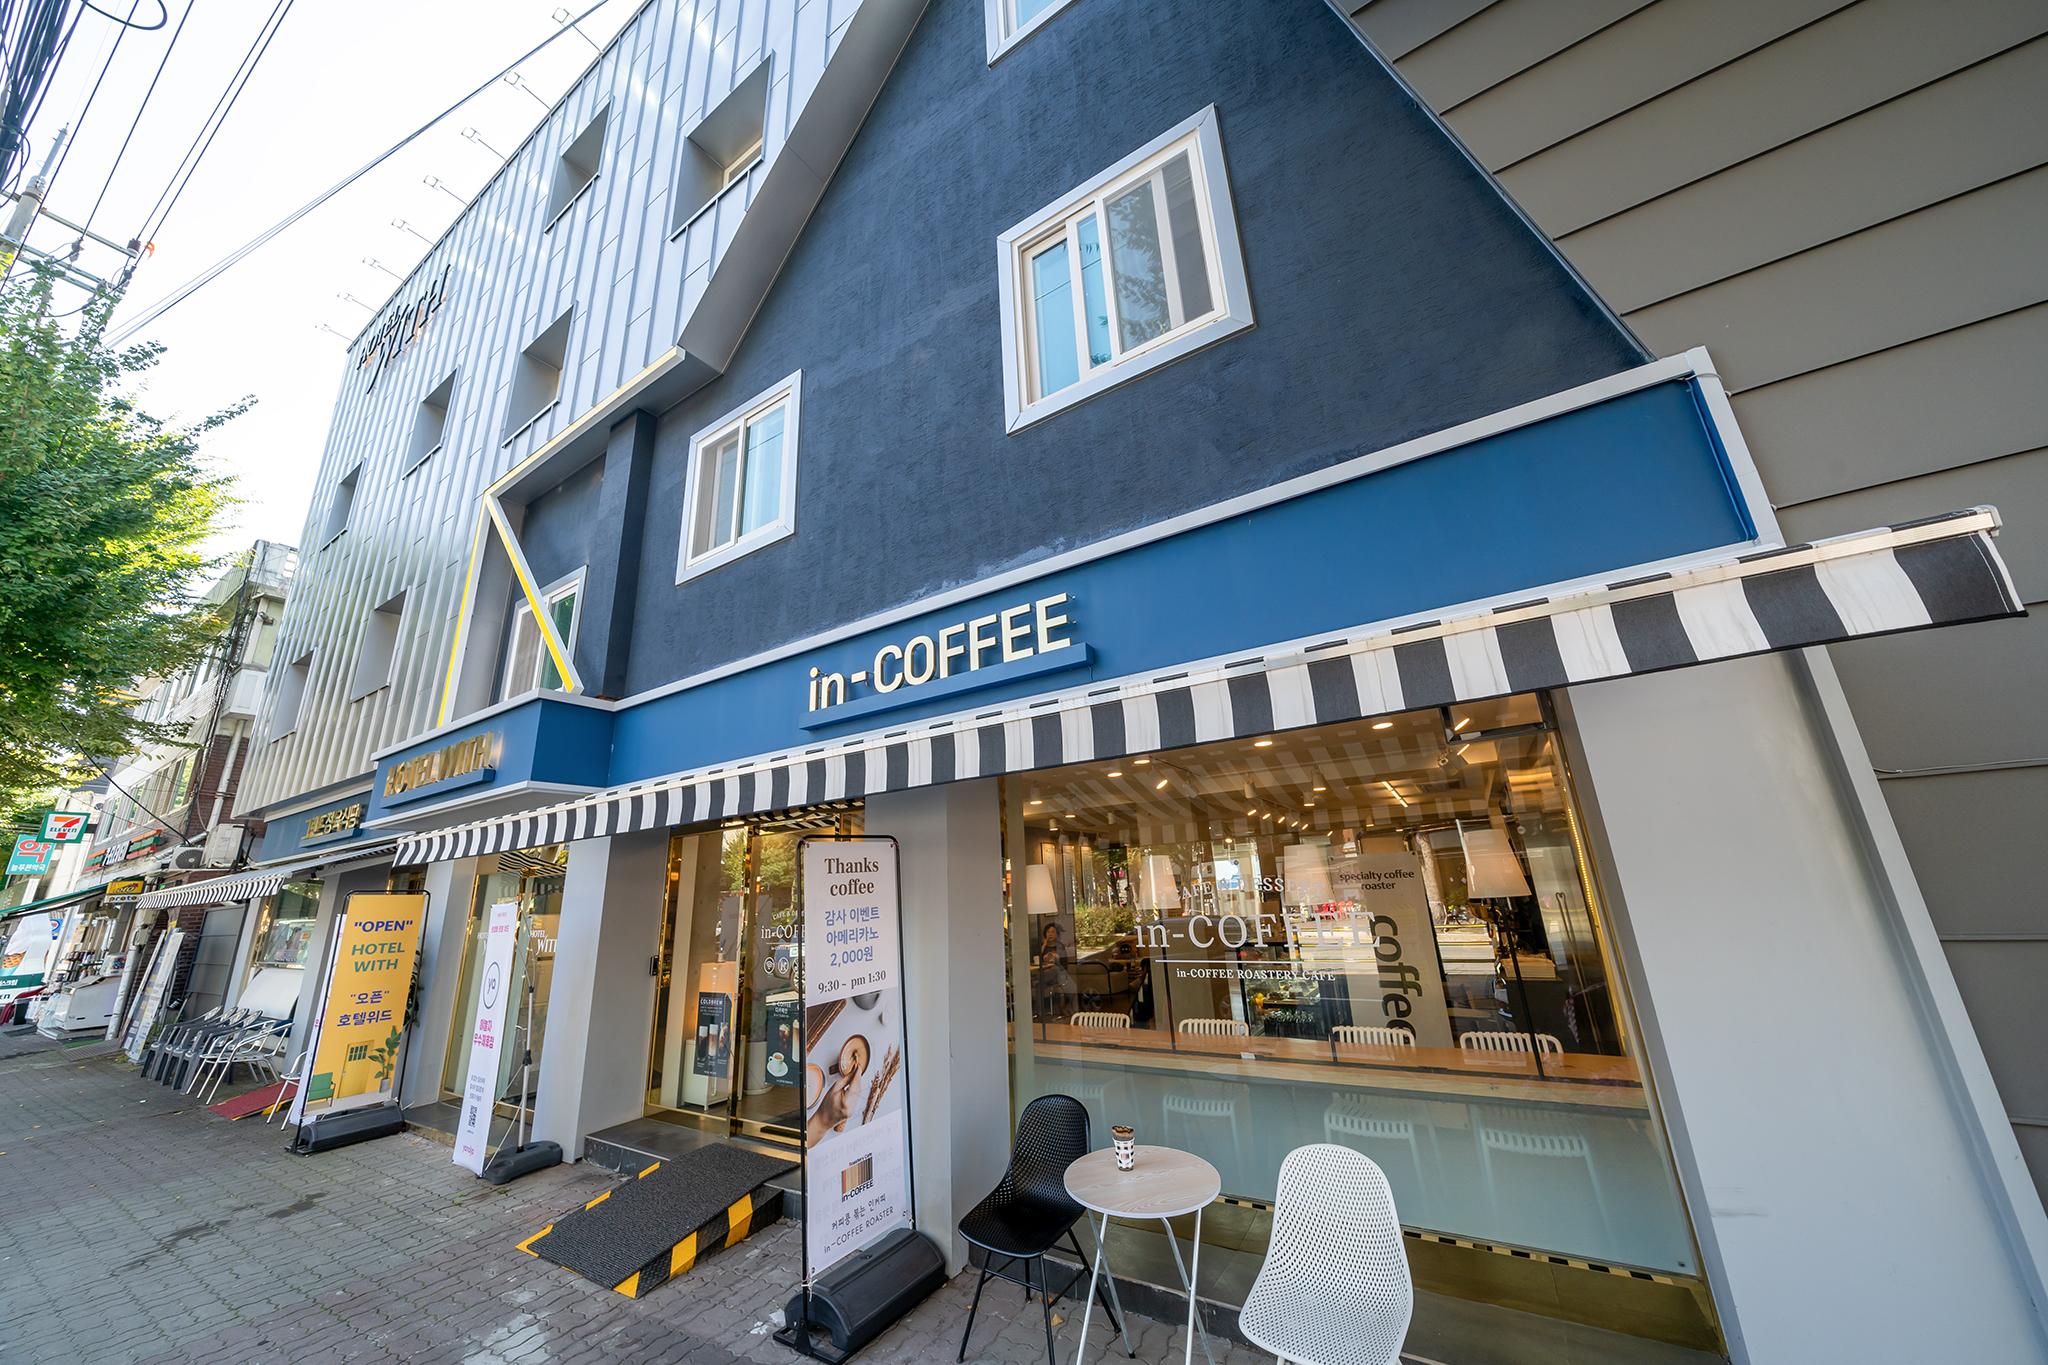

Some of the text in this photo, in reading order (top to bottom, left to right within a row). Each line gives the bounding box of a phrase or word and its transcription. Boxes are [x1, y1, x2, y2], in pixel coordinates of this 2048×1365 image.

[808, 592, 1071, 712] in-COFFEE
[384, 731, 494, 798] HOTEL WITH
[18, 839, 50, 863] 약
[824, 857, 879, 875] Thanks
[1339, 869, 1415, 884] specialty coffee
[1361, 881, 1396, 891] roaster
[830, 879, 875, 897] coffee
[824, 909, 846, 927] 감사
[849, 906, 880, 924] 이벤트
[826, 927, 879, 947] 아메리카노
[1135, 911, 1381, 948] in-COFFEE
[352, 942, 405, 956] HOTEL
[830, 946, 874, 968] 2,000원
[354, 958, 398, 973] WITH
[1176, 967, 1336, 982] in-COFFEE ROASTERY CAFE
[818, 980, 840, 995] 9:30
[851, 976, 866, 990] pm
[868, 970, 887, 984] 1:30
[337, 1009, 393, 1027] 호텔위드
[842, 1178, 874, 1203] in-COFFEE
[824, 1205, 895, 1254] in-COFFEE ROASTER
[832, 1213, 851, 1230] 커피콩
